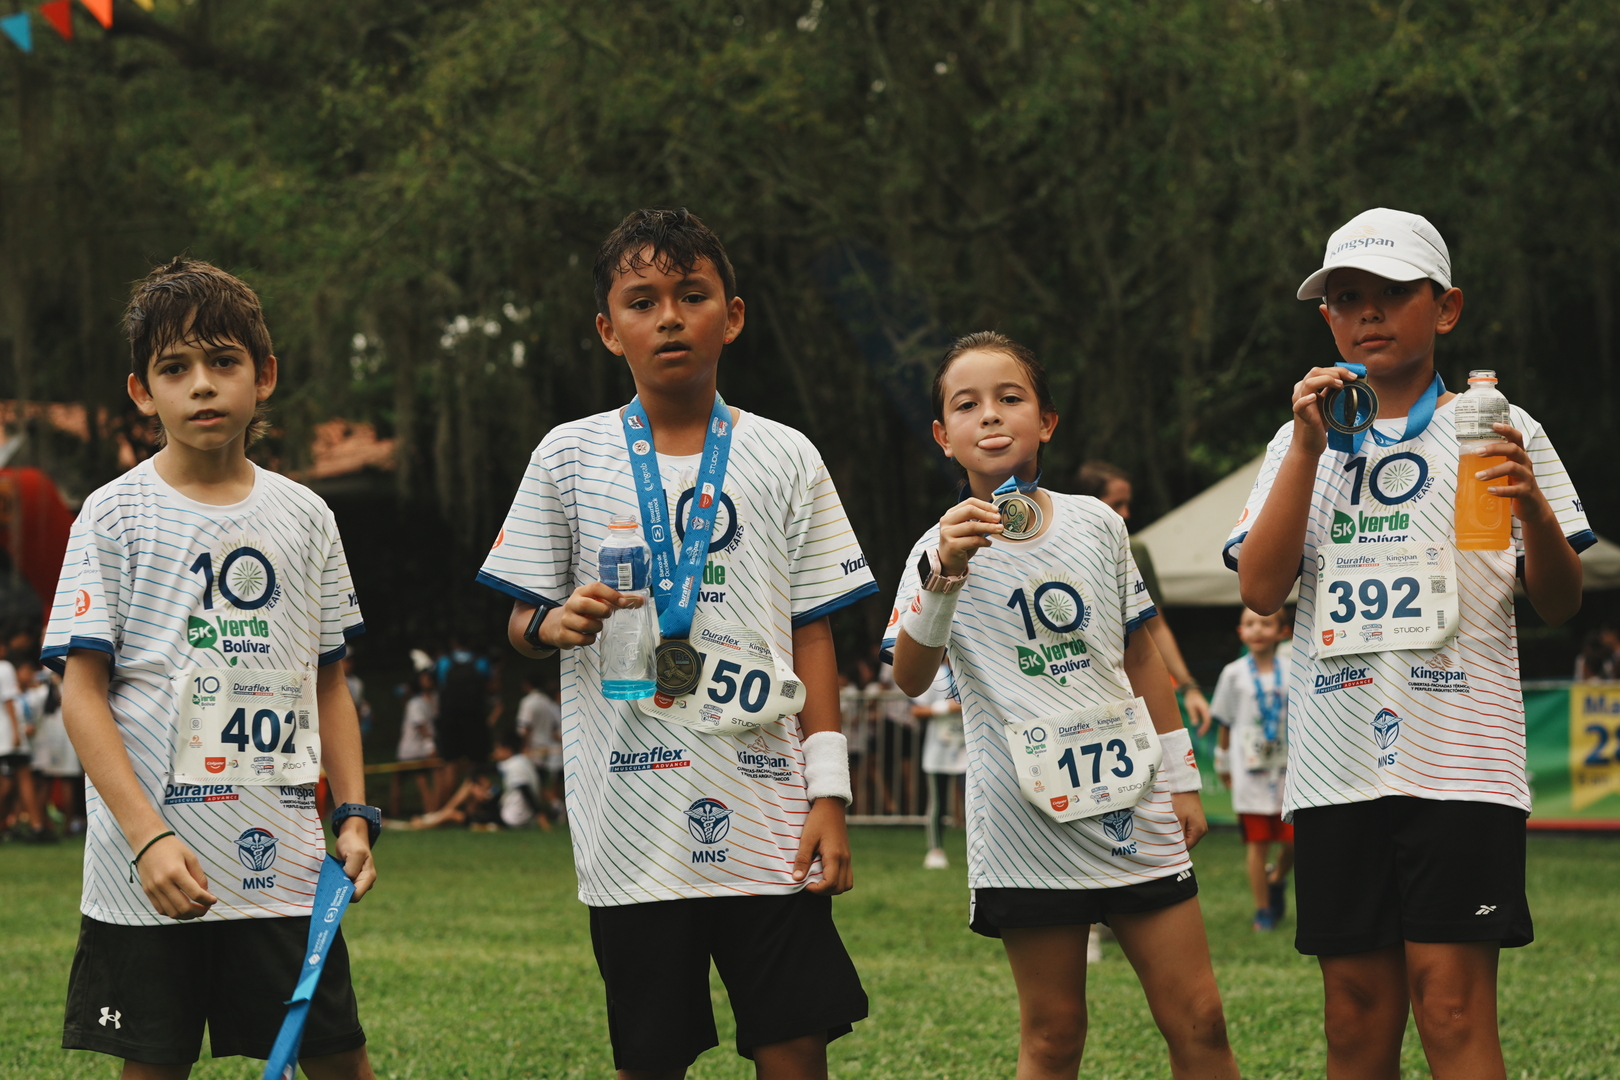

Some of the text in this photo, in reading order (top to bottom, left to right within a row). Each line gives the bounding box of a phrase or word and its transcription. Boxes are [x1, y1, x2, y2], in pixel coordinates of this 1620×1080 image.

[1343, 452, 1428, 506] 10
[1411, 477, 1435, 504] YEARS
[1332, 521, 1354, 538] 5K
[1358, 510, 1410, 533] Verde
[725, 524, 745, 554] YEARS
[1336, 556, 1376, 565] Duraflex
[189, 546, 276, 610] 10
[1328, 577, 1422, 624] 392
[1007, 581, 1084, 640] 10
[1078, 606, 1091, 632] YEARS
[188, 625, 213, 641] 5K
[215, 615, 269, 638] Verde
[1393, 626, 1424, 634] STUDIO
[701, 628, 739, 646] Duraflex
[222, 639, 270, 654] Bolívar
[1039, 637, 1087, 662] Verde
[1019, 654, 1041, 670] 5K
[1050, 658, 1091, 676] Bolívar
[194, 676, 220, 694] 10
[1314, 666, 1368, 688] Duraflex
[1344, 679, 1371, 688] ADVANCE
[233, 683, 271, 692] Duraflex
[221, 707, 297, 753] 402
[1023, 727, 1047, 744] 10
[1059, 722, 1090, 734] Duraflex
[609, 746, 683, 765] Duraflex
[1057, 738, 1134, 788] 173
[1377, 754, 1395, 769] MNS
[655, 761, 687, 769] ADVANCE
[1117, 783, 1142, 794] STUDIO
[692, 850, 726, 863] MNS
[1112, 844, 1137, 857] MNS
[243, 876, 275, 890] MNS
